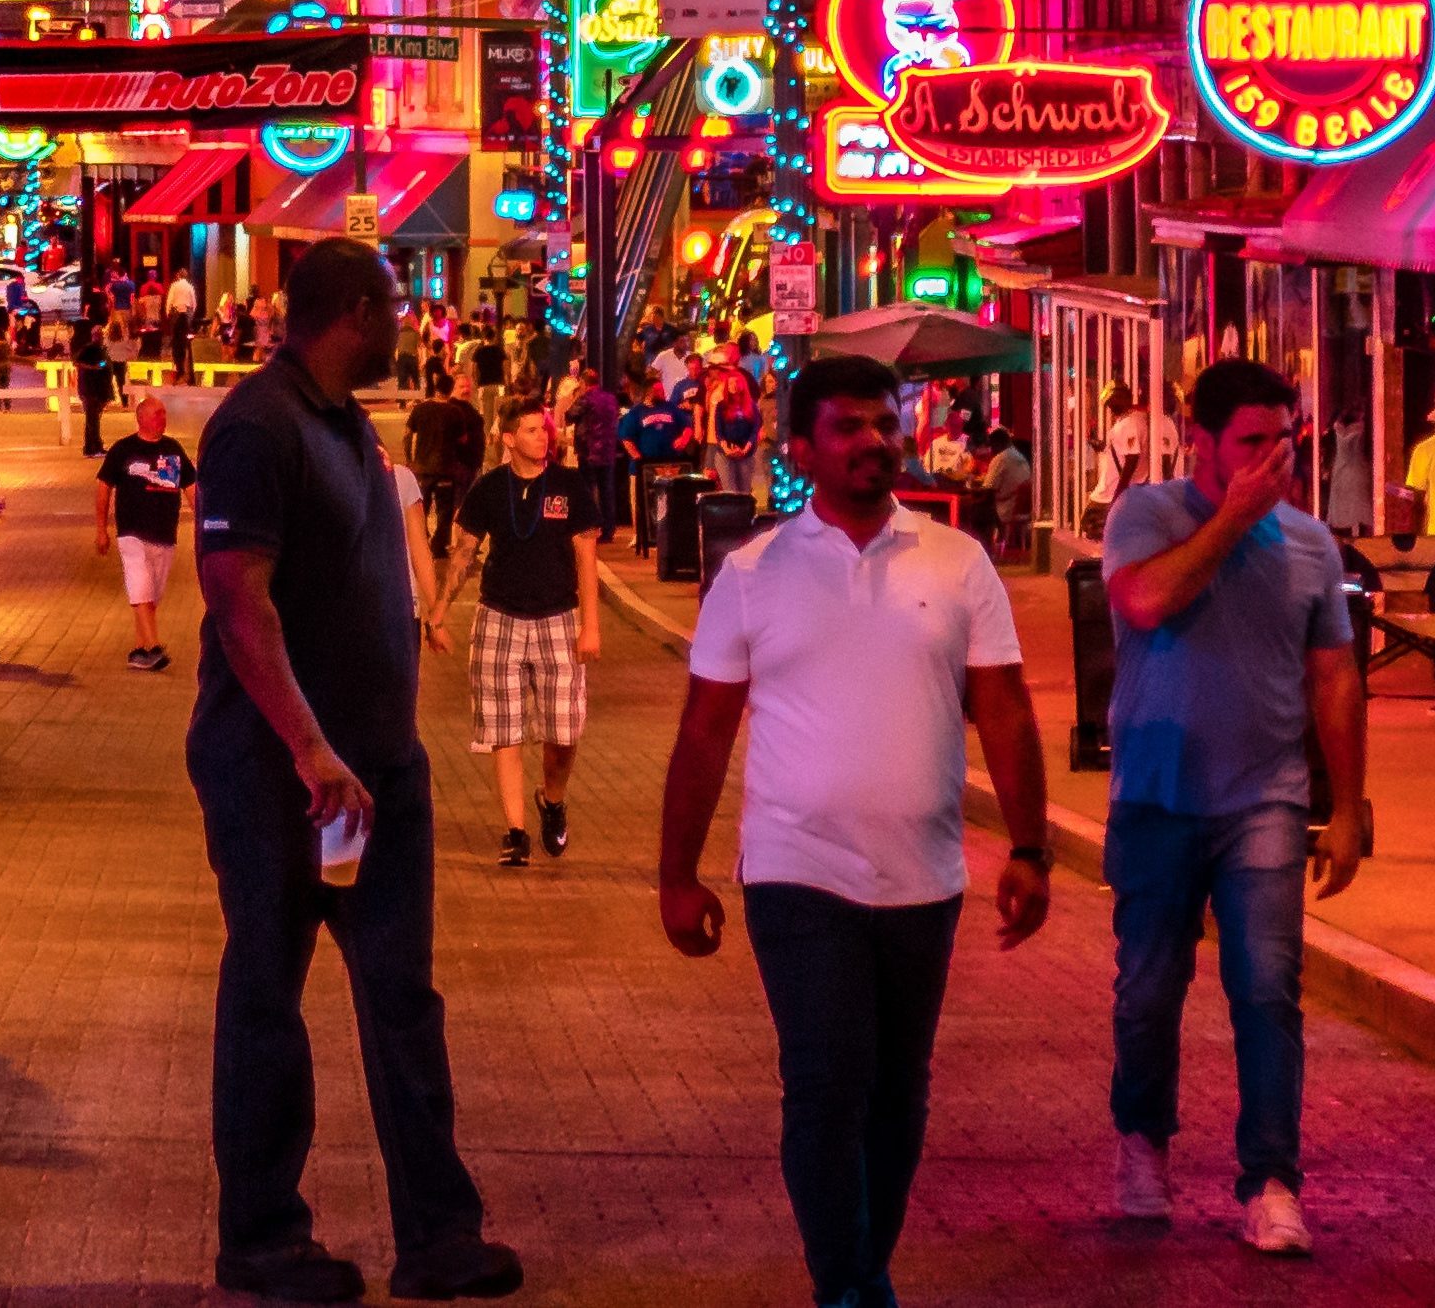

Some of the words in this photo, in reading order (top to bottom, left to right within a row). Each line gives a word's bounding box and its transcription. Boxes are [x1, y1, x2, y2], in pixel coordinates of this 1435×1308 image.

[393, 39, 422, 59] King
[426, 39, 458, 60] Blvd.
[1207, 2, 1426, 60] RESTAURANT
[143, 63, 357, 111] AutoZone
[900, 80, 952, 132] A.
[958, 78, 1152, 133] Schwab
[1224, 72, 1281, 128] 159
[1296, 69, 1416, 148] BEALE
[945, 147, 1079, 169] ESTABLISHED
[348, 216, 376, 232] 25
